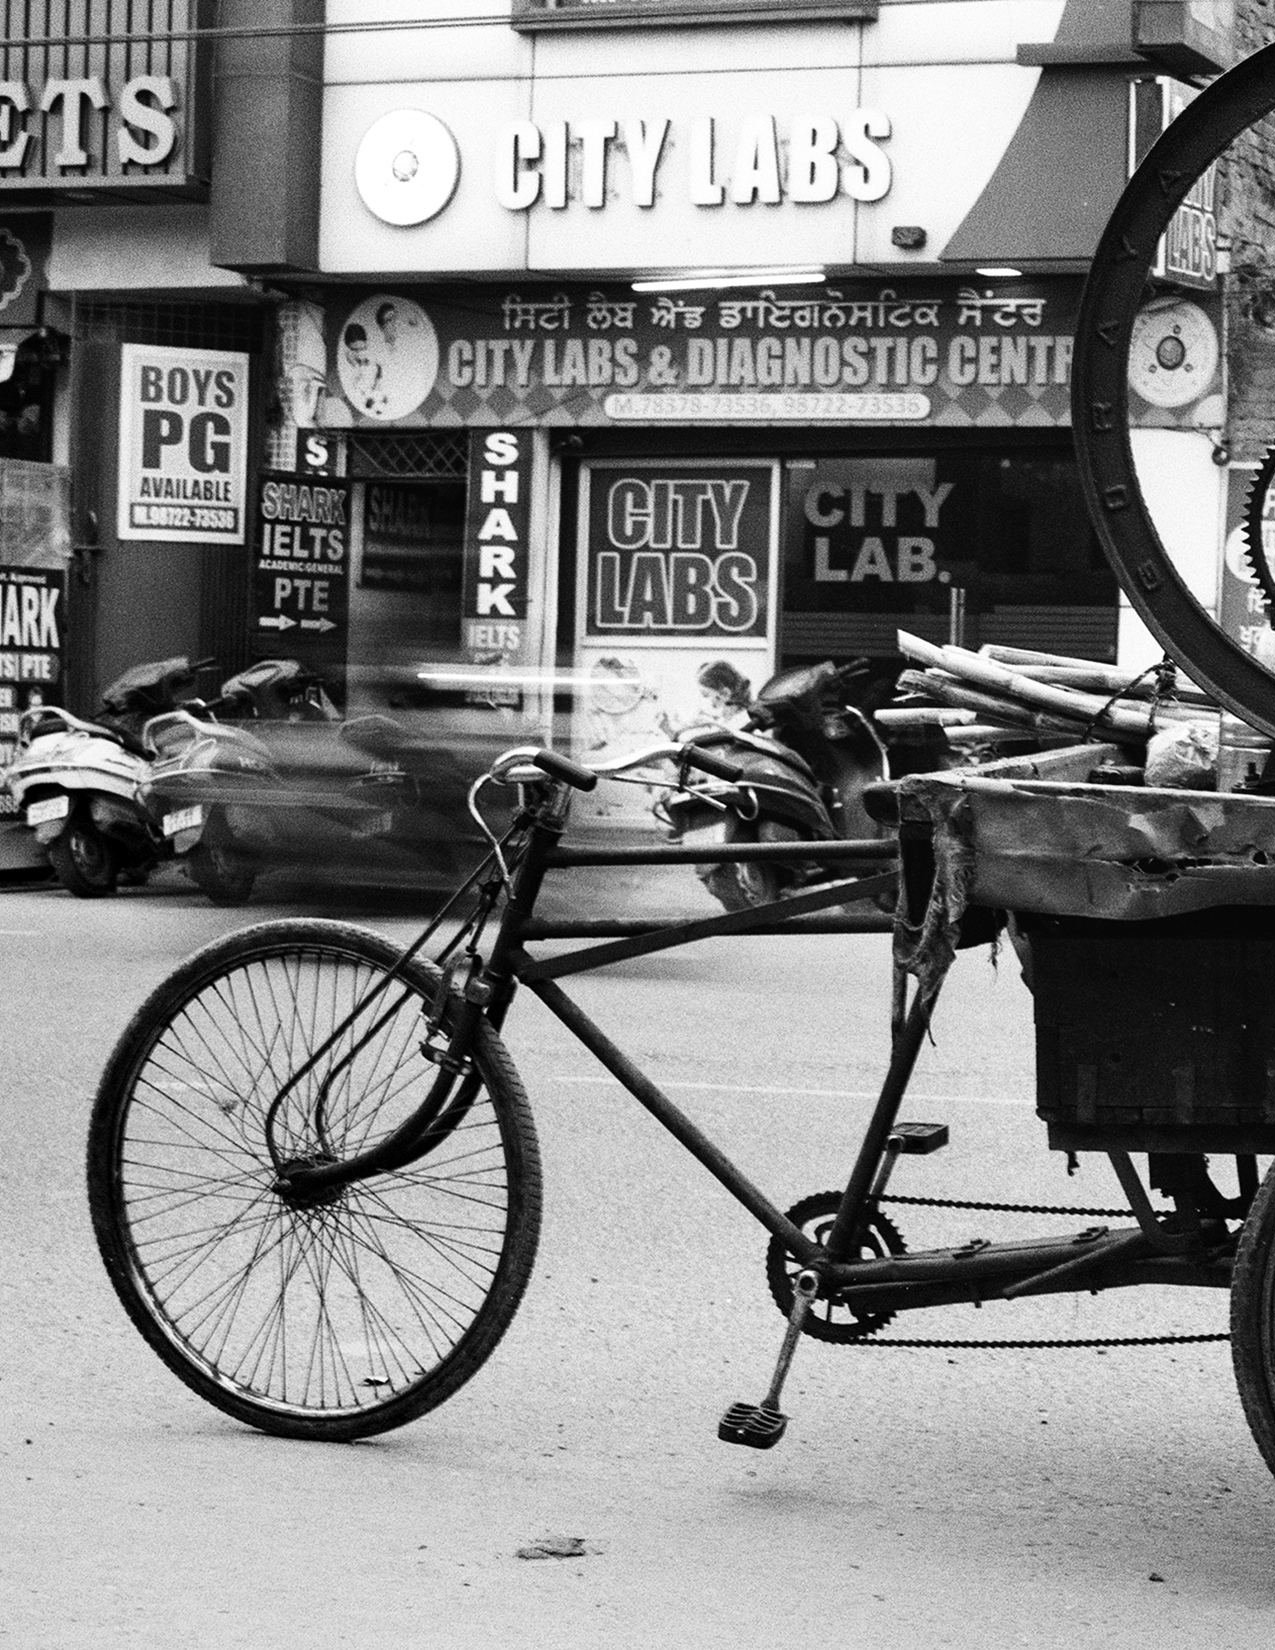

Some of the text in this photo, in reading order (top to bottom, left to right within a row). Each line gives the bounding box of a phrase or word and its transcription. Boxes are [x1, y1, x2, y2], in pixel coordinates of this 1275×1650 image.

[497, 108, 893, 210] CITY LABS
[501, 293, 573, 329] ਸਿਟੀ
[448, 338, 535, 386] CITY
[543, 337, 639, 386] LABS
[650, 345, 677, 386] &
[688, 336, 938, 386] DIAGNOSTIC
[141, 365, 235, 409] BOYS
[142, 409, 231, 474] PG
[140, 477, 232, 502] AVAILABLE
[261, 482, 347, 526] SHARK
[804, 482, 955, 528] CITY
[477, 432, 519, 616] SHARK
[608, 478, 750, 549] CITY
[262, 523, 344, 561] IELTS
[815, 536, 951, 583] LAB.
[274, 577, 330, 612] PTE
[595, 552, 758, 632] LABS
[0, 584, 60, 648] ARK
[469, 625, 521, 650] IELTS
[22, 653, 51, 679] PTE
